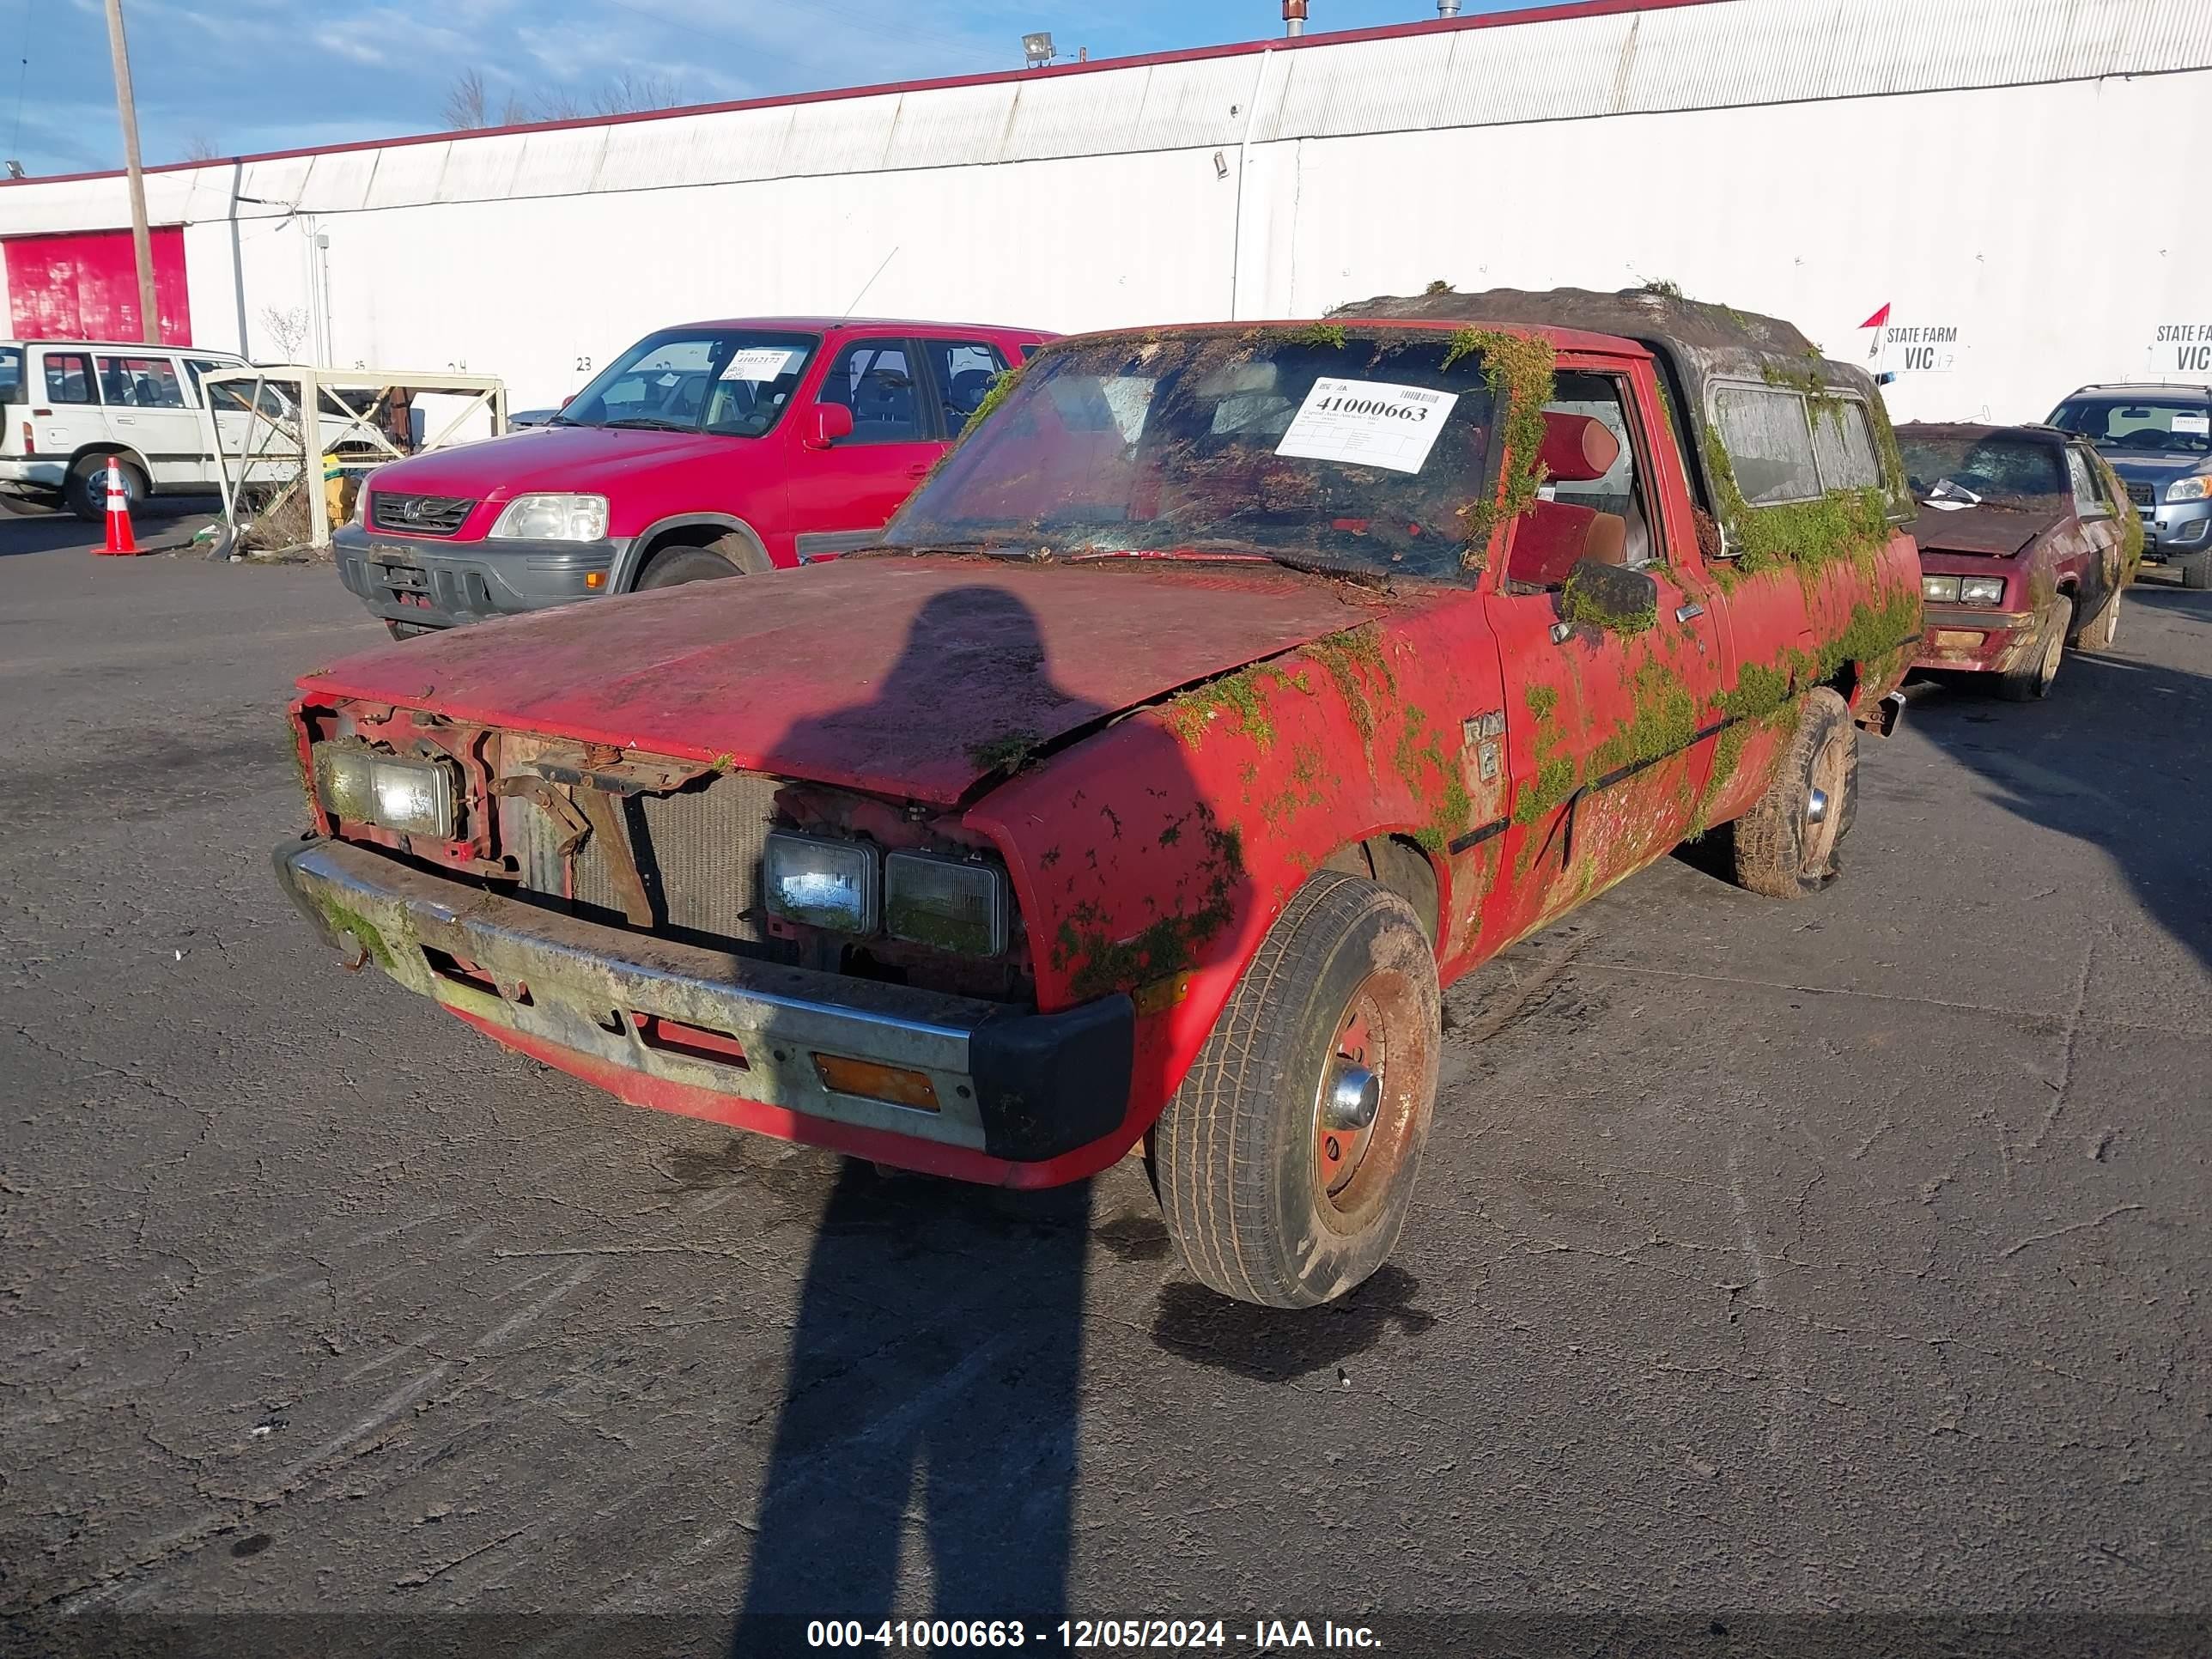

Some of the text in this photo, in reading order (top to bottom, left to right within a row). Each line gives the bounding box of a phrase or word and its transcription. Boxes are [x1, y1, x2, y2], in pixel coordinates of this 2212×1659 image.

[1887, 327, 1957, 343] STATE FARM
[2157, 325, 2195, 341] STATE
[576, 356, 592, 371] 23
[1905, 347, 1934, 369] VIC
[2178, 346, 2210, 370] VIC
[1316, 396, 1428, 422] 41000663
